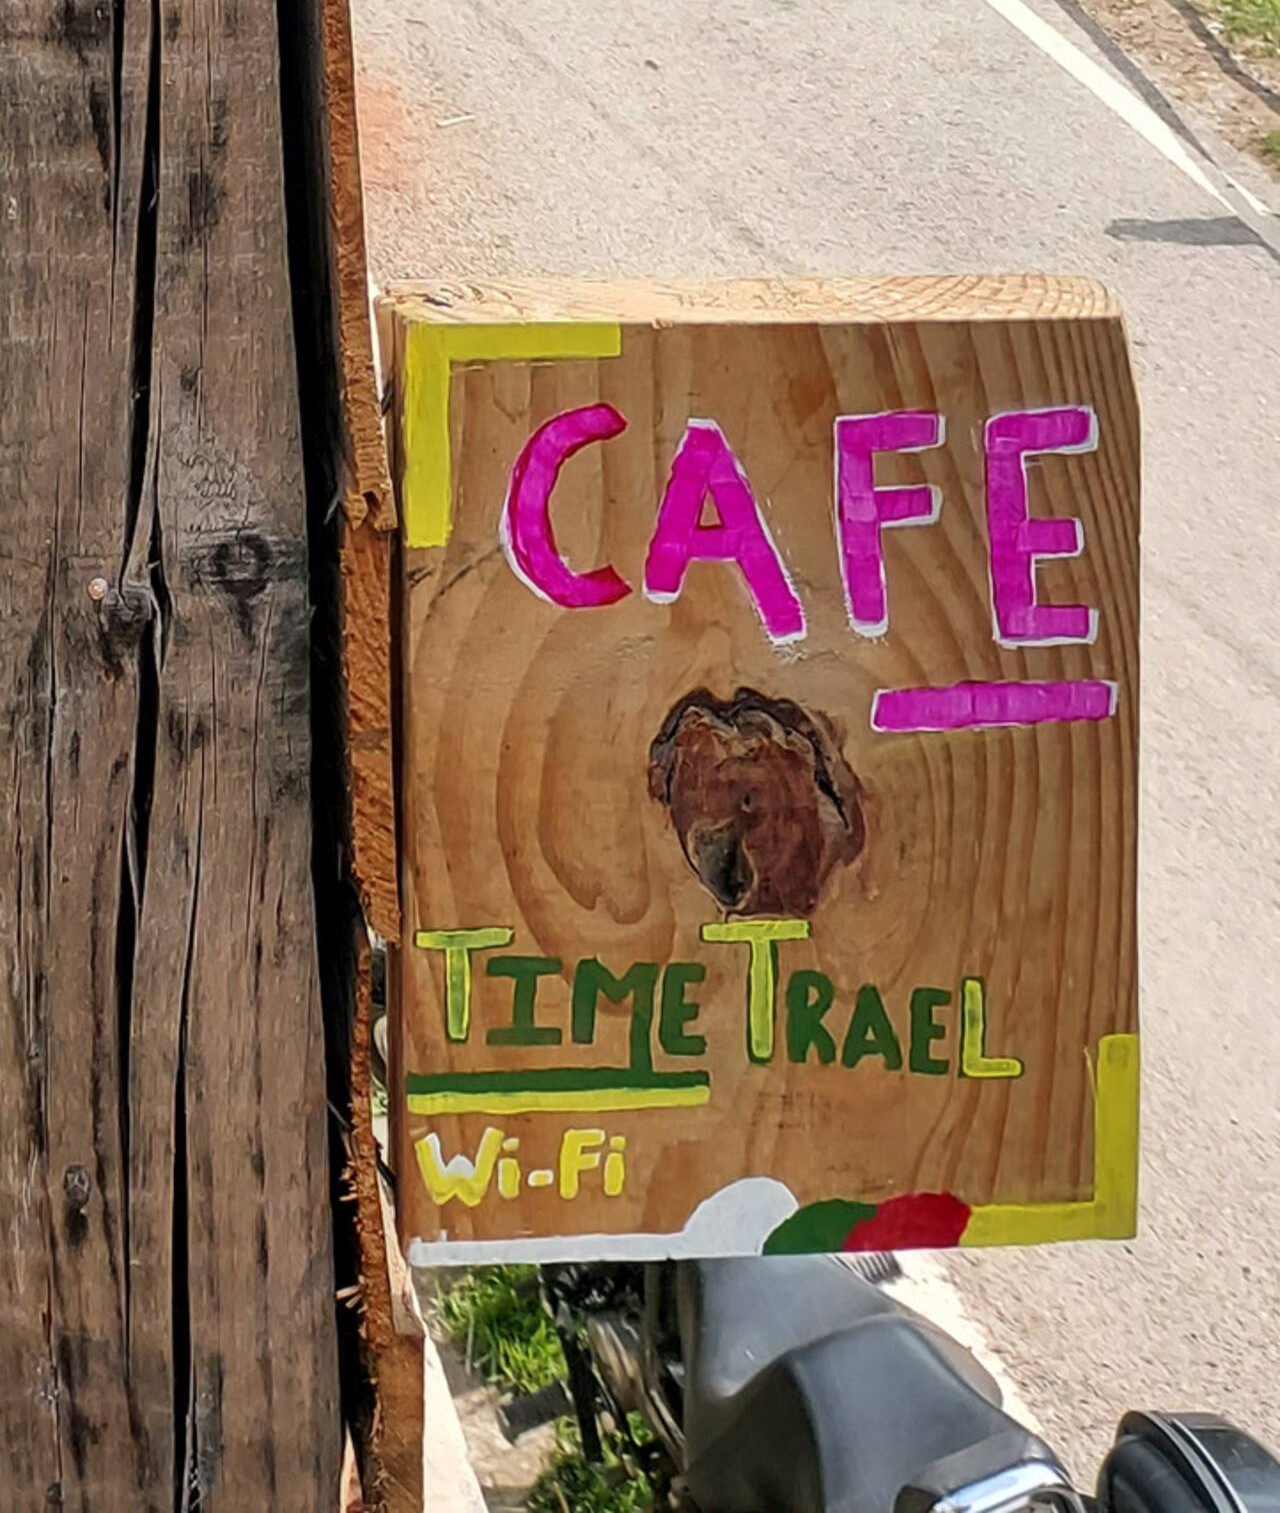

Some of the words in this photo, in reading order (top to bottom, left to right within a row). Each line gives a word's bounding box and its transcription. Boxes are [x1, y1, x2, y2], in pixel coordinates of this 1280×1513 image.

[499, 402, 1099, 649] CAFE
[415, 926, 708, 1072] TIME
[700, 918, 1023, 1078] TRAEL
[415, 1126, 628, 1207] Wi-Fi
